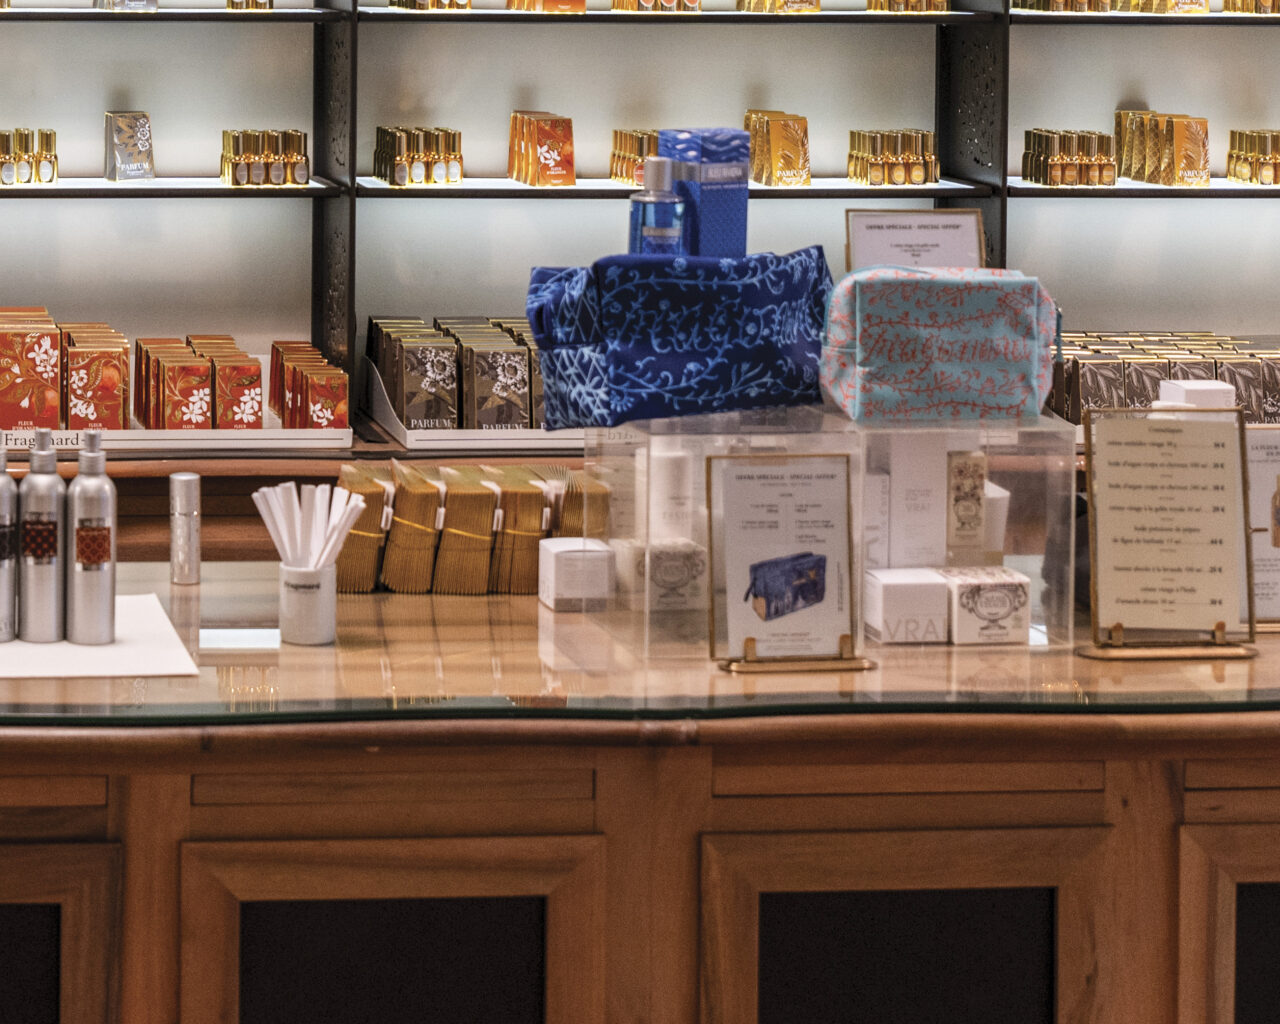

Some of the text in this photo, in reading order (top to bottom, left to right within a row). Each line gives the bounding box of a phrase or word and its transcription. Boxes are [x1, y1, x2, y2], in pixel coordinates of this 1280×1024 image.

[121, 162, 149, 170] PARFUM
[411, 419, 450, 429] PARFUM
[5, 433, 80, 450] Fragnard
